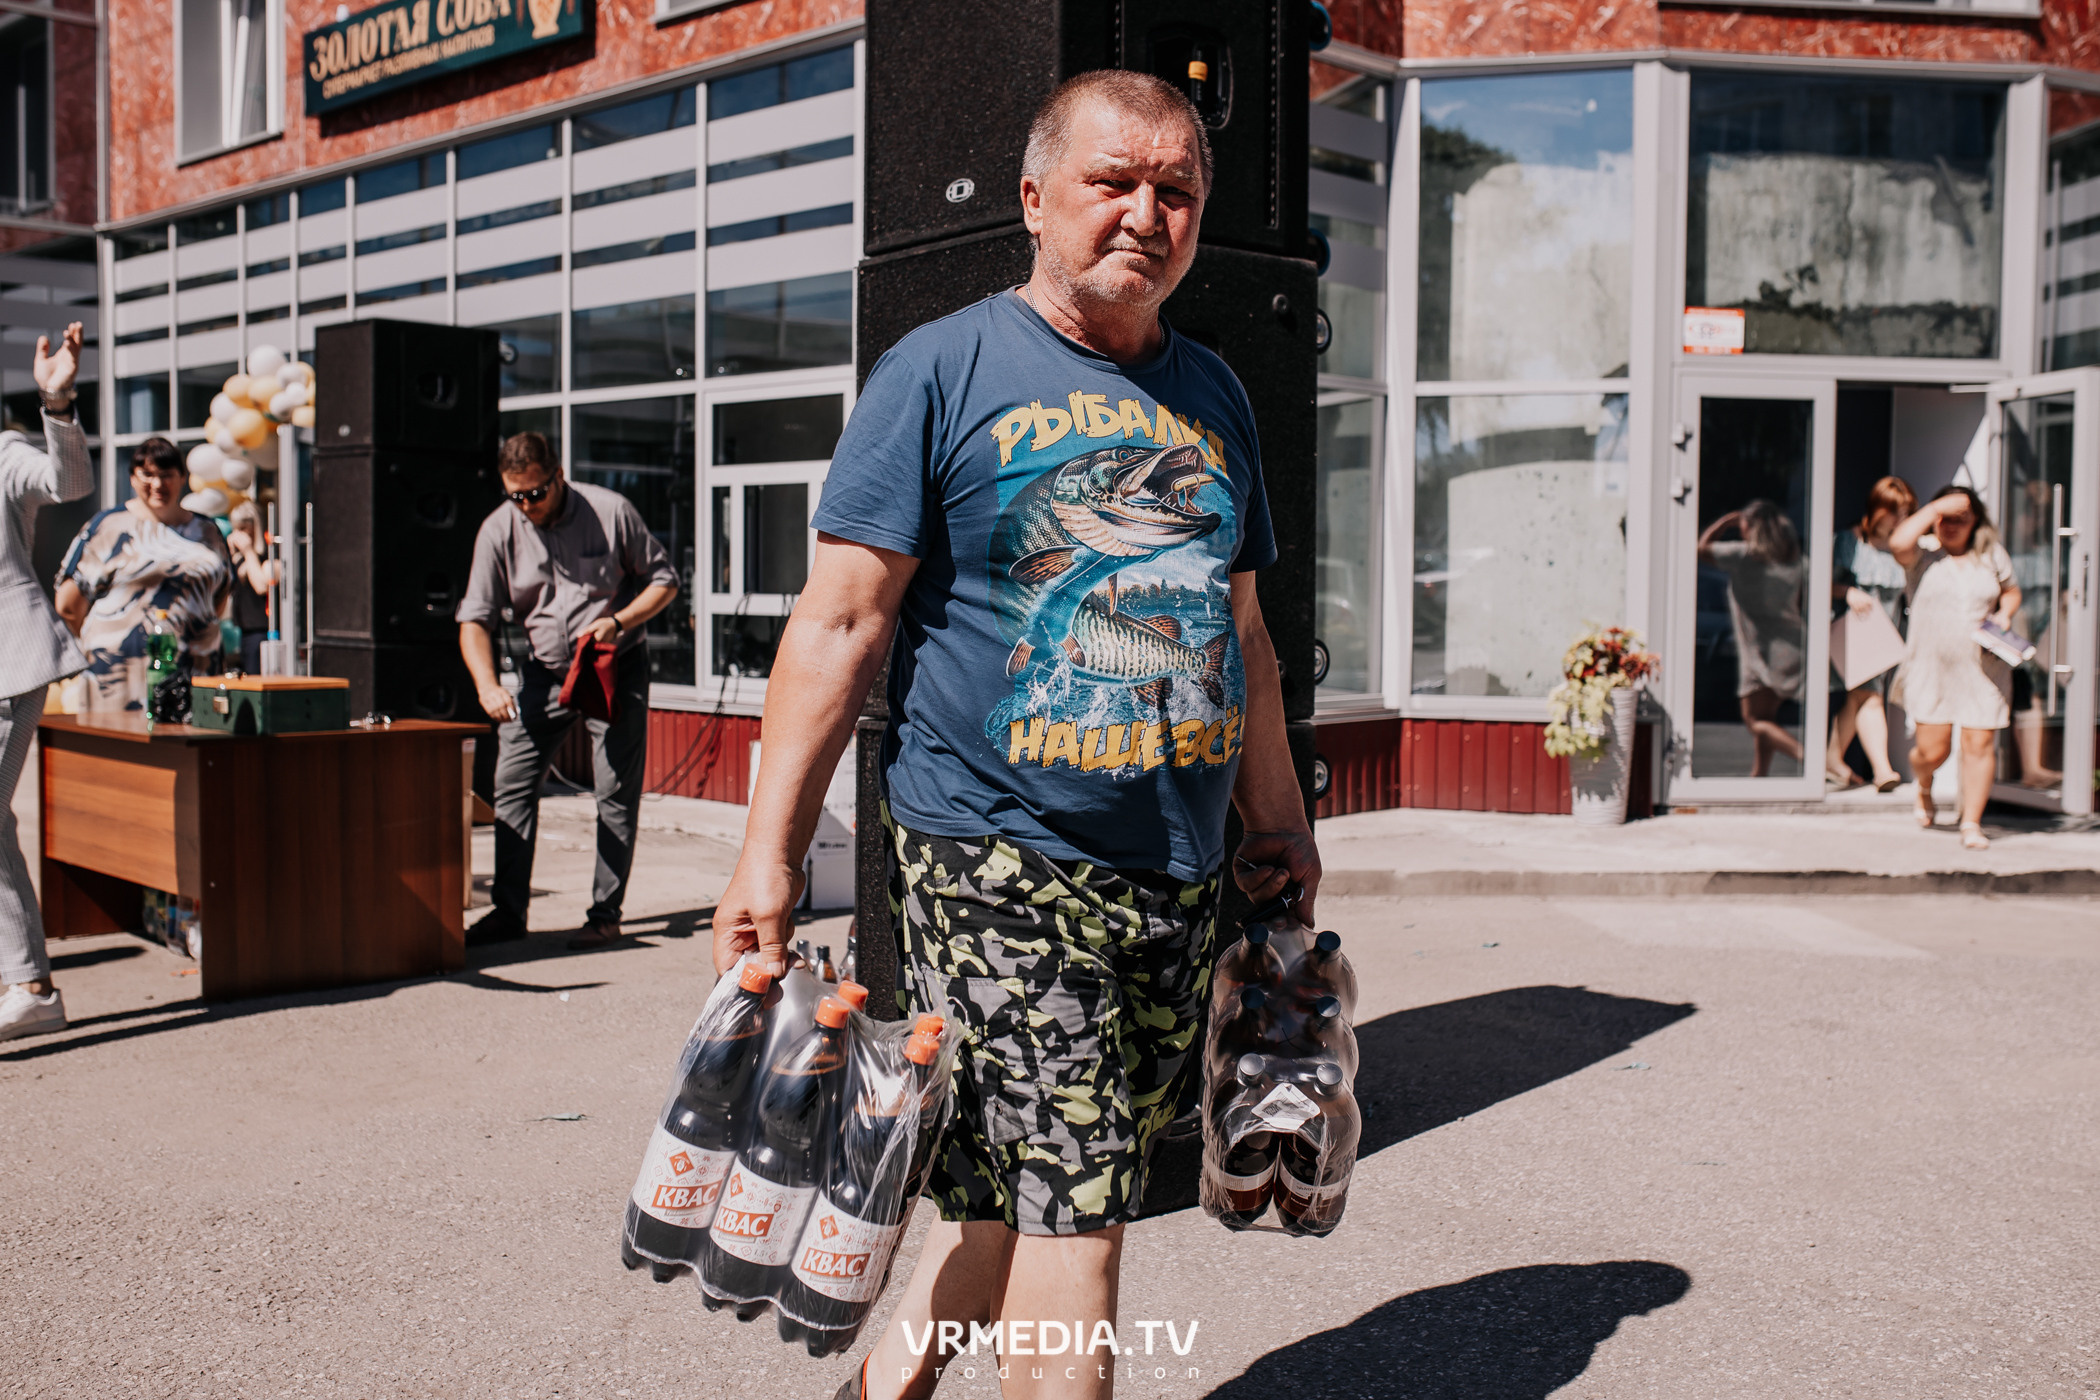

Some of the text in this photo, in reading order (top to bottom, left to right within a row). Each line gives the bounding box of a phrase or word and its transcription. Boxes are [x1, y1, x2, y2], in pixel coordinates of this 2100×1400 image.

[309, 0, 430, 82] ЗОЛОТАЯ
[990, 389, 1229, 478] РЫБАЛКА
[1008, 716, 1170, 773] НАШЕ
[656, 1183, 719, 1208] КВАС
[715, 1207, 768, 1236] КВАС
[803, 1248, 866, 1276] КВАС
